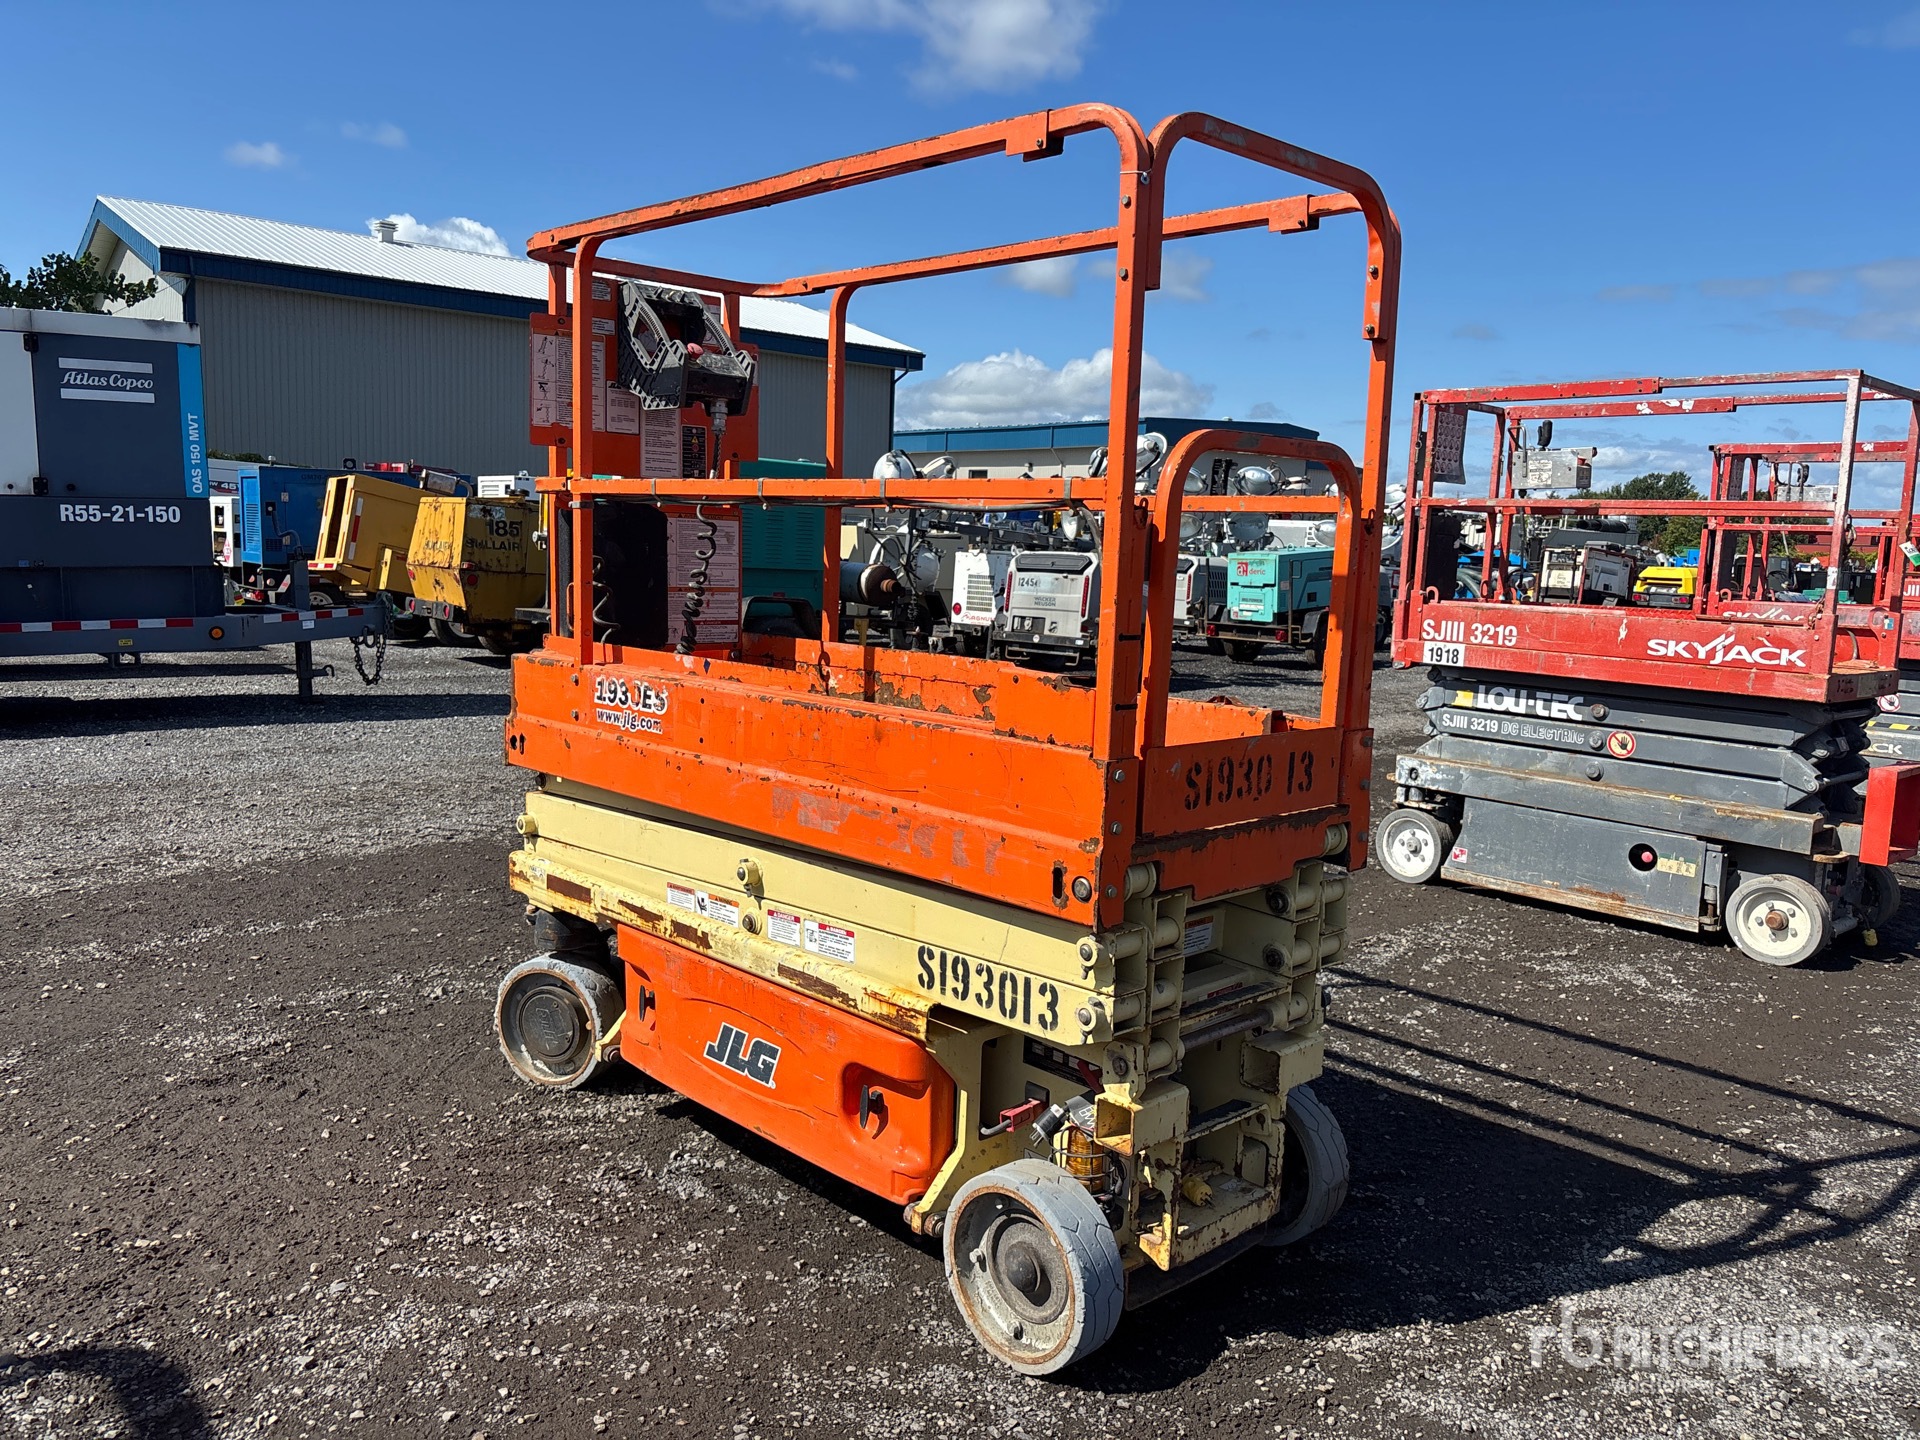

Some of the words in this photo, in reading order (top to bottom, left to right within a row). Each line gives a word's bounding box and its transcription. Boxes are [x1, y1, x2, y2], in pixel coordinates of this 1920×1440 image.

[60, 371, 107, 386] Atlas
[109, 374, 154, 390] Copco
[187, 413, 200, 441] MVT
[190, 444, 201, 465] 150
[60, 504, 181, 523] R55-21-150
[487, 520, 523, 538] 185
[1421, 619, 1465, 642] SJIII
[1470, 622, 1518, 647] 3219
[1428, 647, 1460, 665] 1918
[1647, 633, 1807, 668] SKYJACK
[1477, 685, 1585, 721] LOU-TEC
[596, 710, 663, 732] www.jlg.com
[1442, 713, 1468, 729] SJIII
[1470, 717, 1499, 732] 3219
[1501, 721, 1519, 736] DC
[1520, 724, 1585, 744] ELECTRIC
[917, 944, 1059, 1032] S193013
[703, 1022, 781, 1088] JLG
